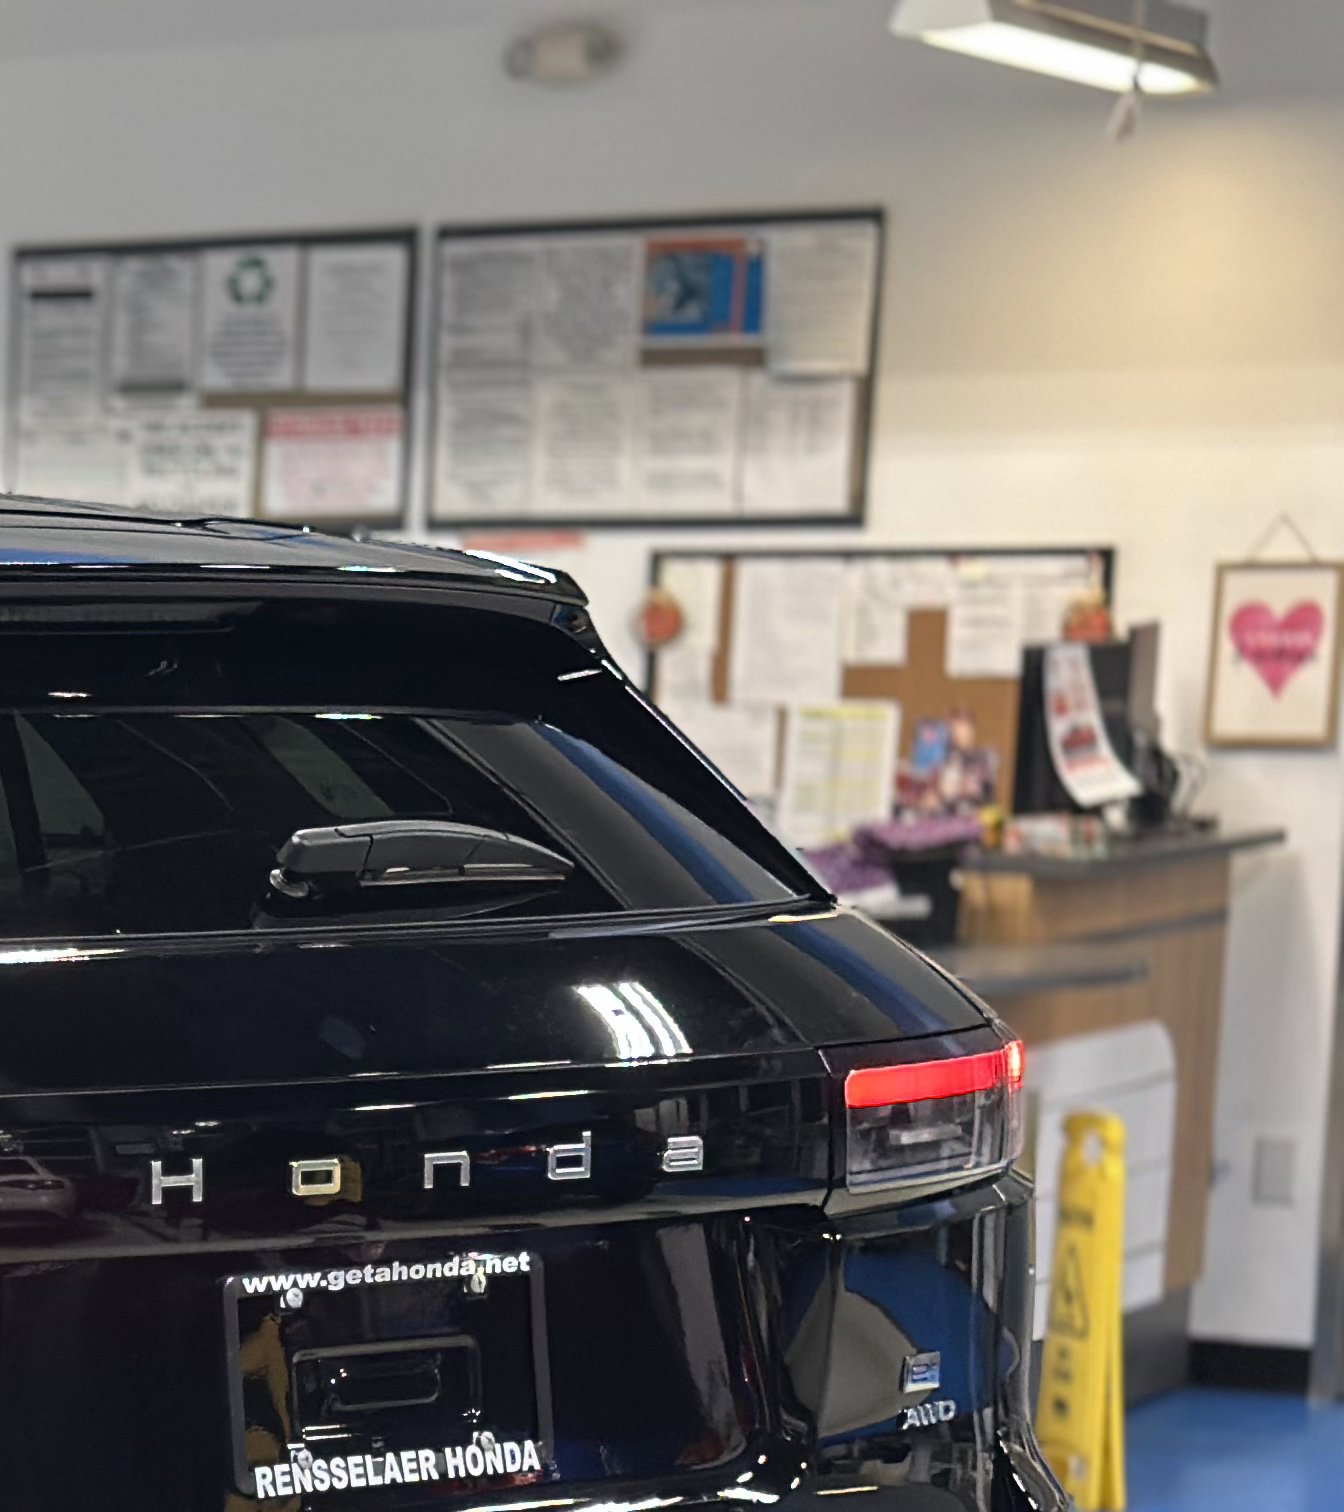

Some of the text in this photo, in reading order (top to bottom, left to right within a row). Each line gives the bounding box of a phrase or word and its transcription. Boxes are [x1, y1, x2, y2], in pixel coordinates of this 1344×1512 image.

[242, 1251, 531, 1291] www.getahonda.net
[900, 1400, 955, 1429] AWD
[255, 1439, 541, 1499] RENSSELAER HONDA
